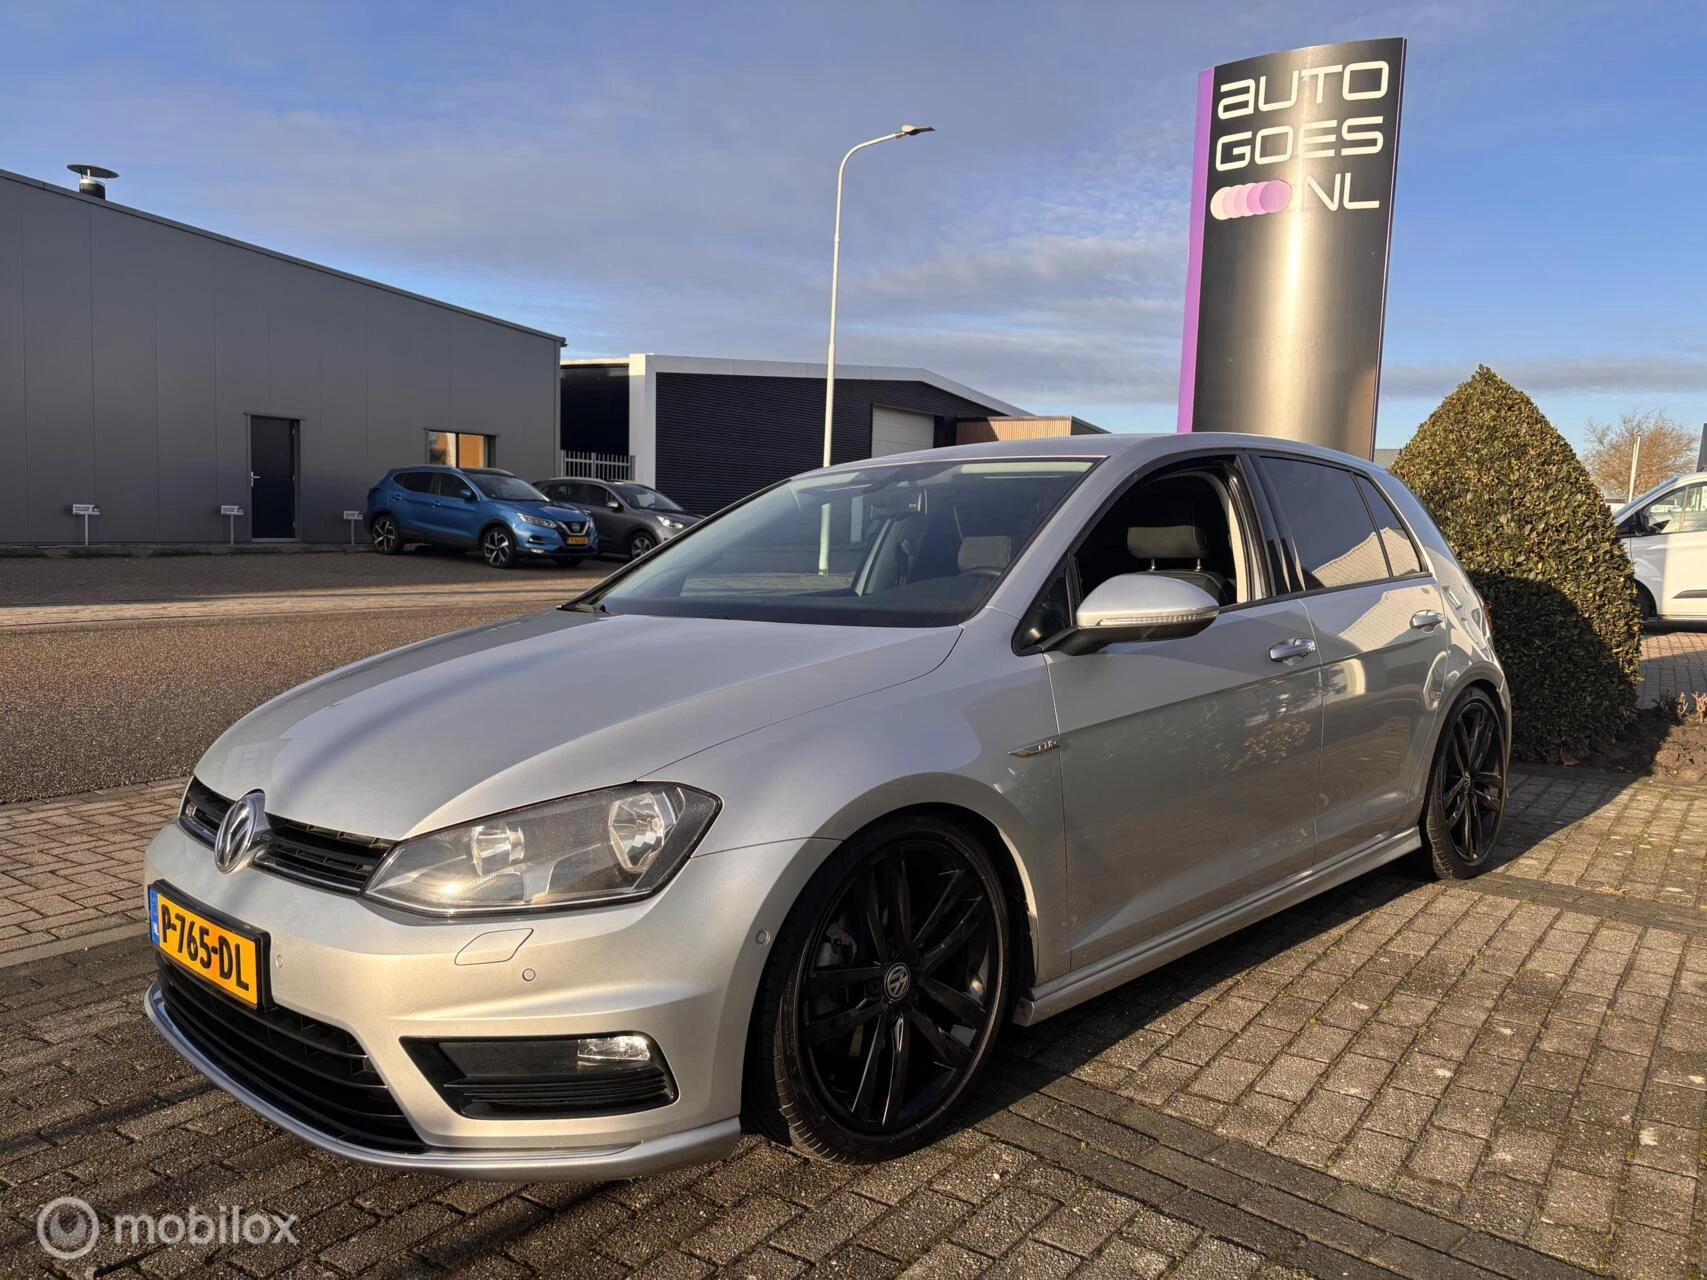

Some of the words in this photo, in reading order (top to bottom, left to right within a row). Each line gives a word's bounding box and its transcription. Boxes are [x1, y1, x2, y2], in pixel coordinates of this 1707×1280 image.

[1215, 115, 1384, 172] GOES
[1305, 172, 1380, 212] NL
[161, 903, 250, 992] P-765-DL
